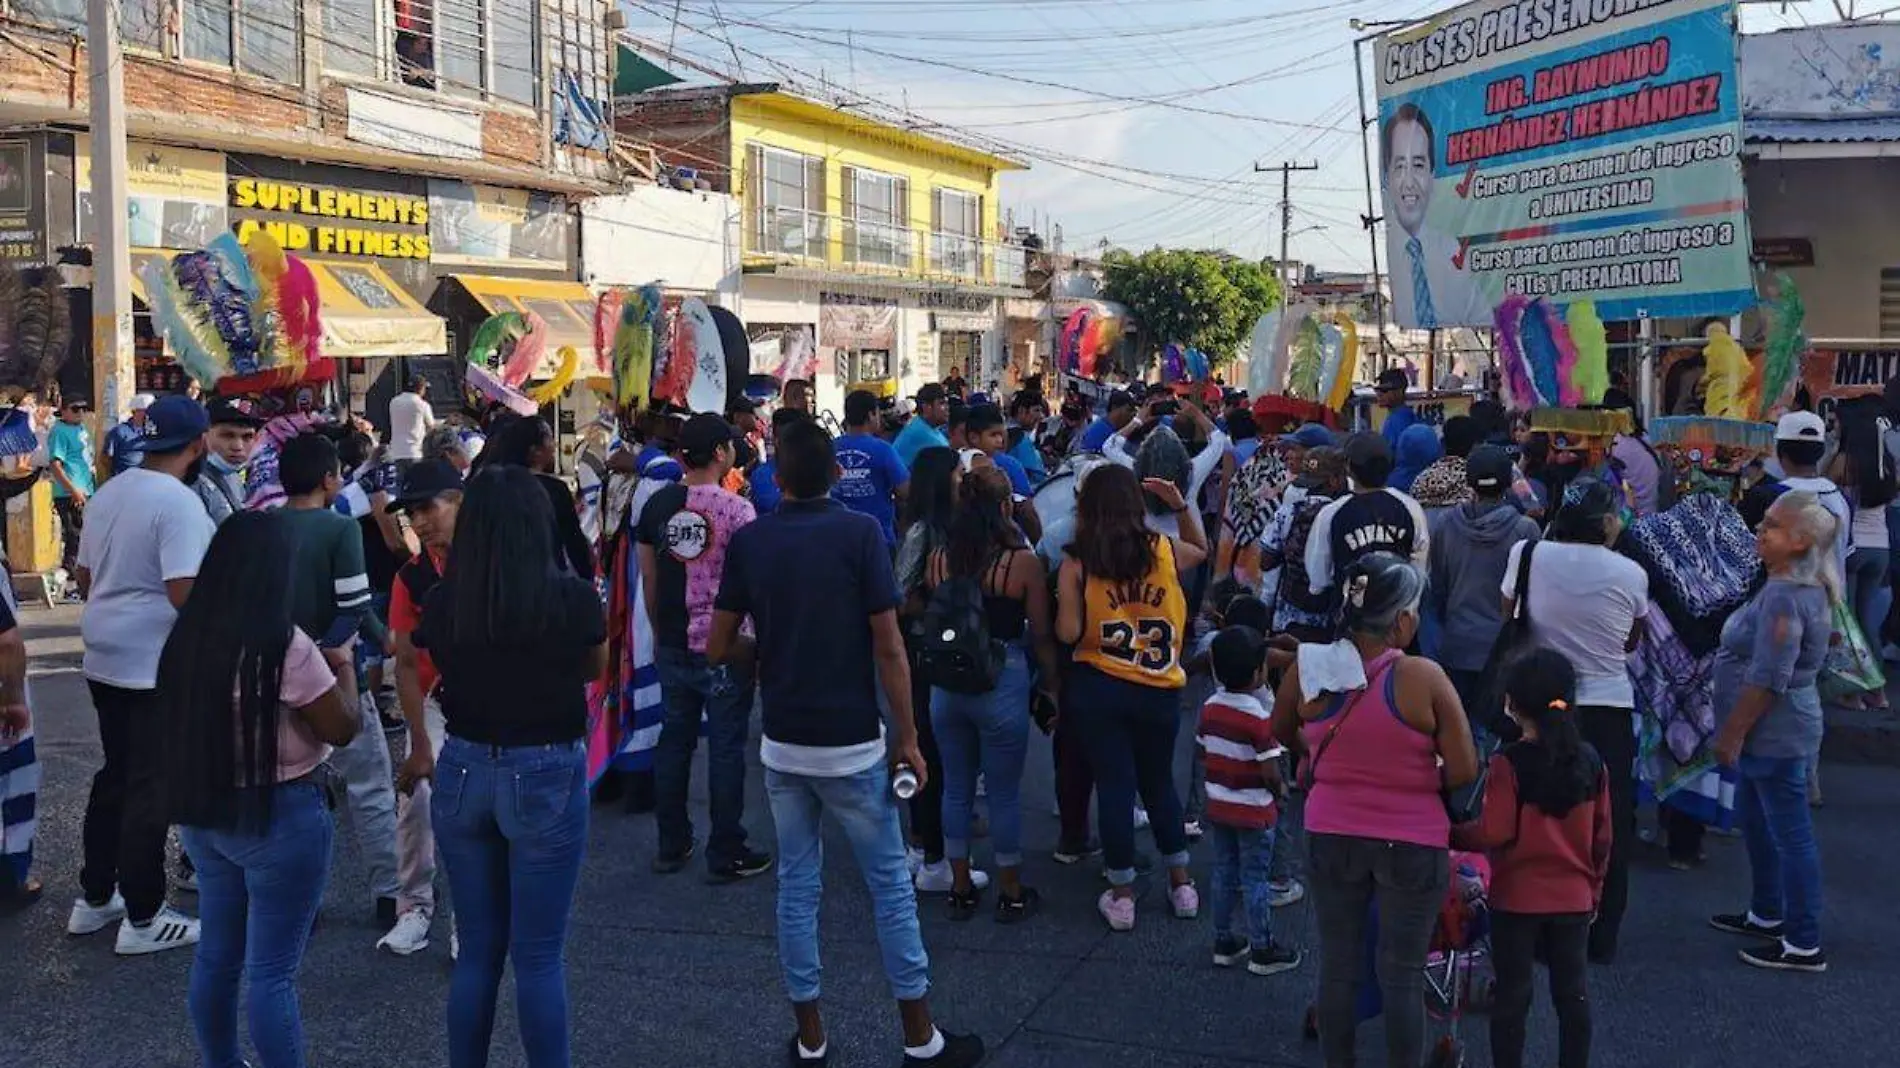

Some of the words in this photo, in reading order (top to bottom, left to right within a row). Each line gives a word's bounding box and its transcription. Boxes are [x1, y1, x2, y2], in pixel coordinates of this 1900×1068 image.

[1385, 17, 1475, 84] CLASES
[1476, 0, 1672, 57] PRESENC
[1485, 75, 1529, 115] ING.
[1534, 36, 1671, 104] RAYMUNDO
[1446, 108, 1568, 165] HERNÁNDEZ
[1571, 73, 1721, 140] HERNÁNDEZ
[1474, 173, 1516, 198] Curso
[1520, 166, 1556, 190] para
[1559, 154, 1626, 183] examen
[1628, 147, 1651, 171] de
[1655, 134, 1733, 167] ingreso
[236, 178, 428, 225] SUPLEMENTS
[1530, 200, 1541, 219] a
[1542, 178, 1654, 217] UNIVERSIDAD
[238, 219, 310, 249] AND
[318, 227, 430, 258] FITNESS
[1471, 250, 1512, 271] Curso
[1514, 244, 1549, 268] para
[1551, 234, 1617, 262] examen
[1619, 230, 1643, 254] de
[1644, 224, 1714, 253] ingreso
[1719, 222, 1733, 245] a
[1549, 274, 1559, 294] y
[1560, 258, 1681, 292] PREPARATORIA
[1100, 617, 1176, 675] 23
